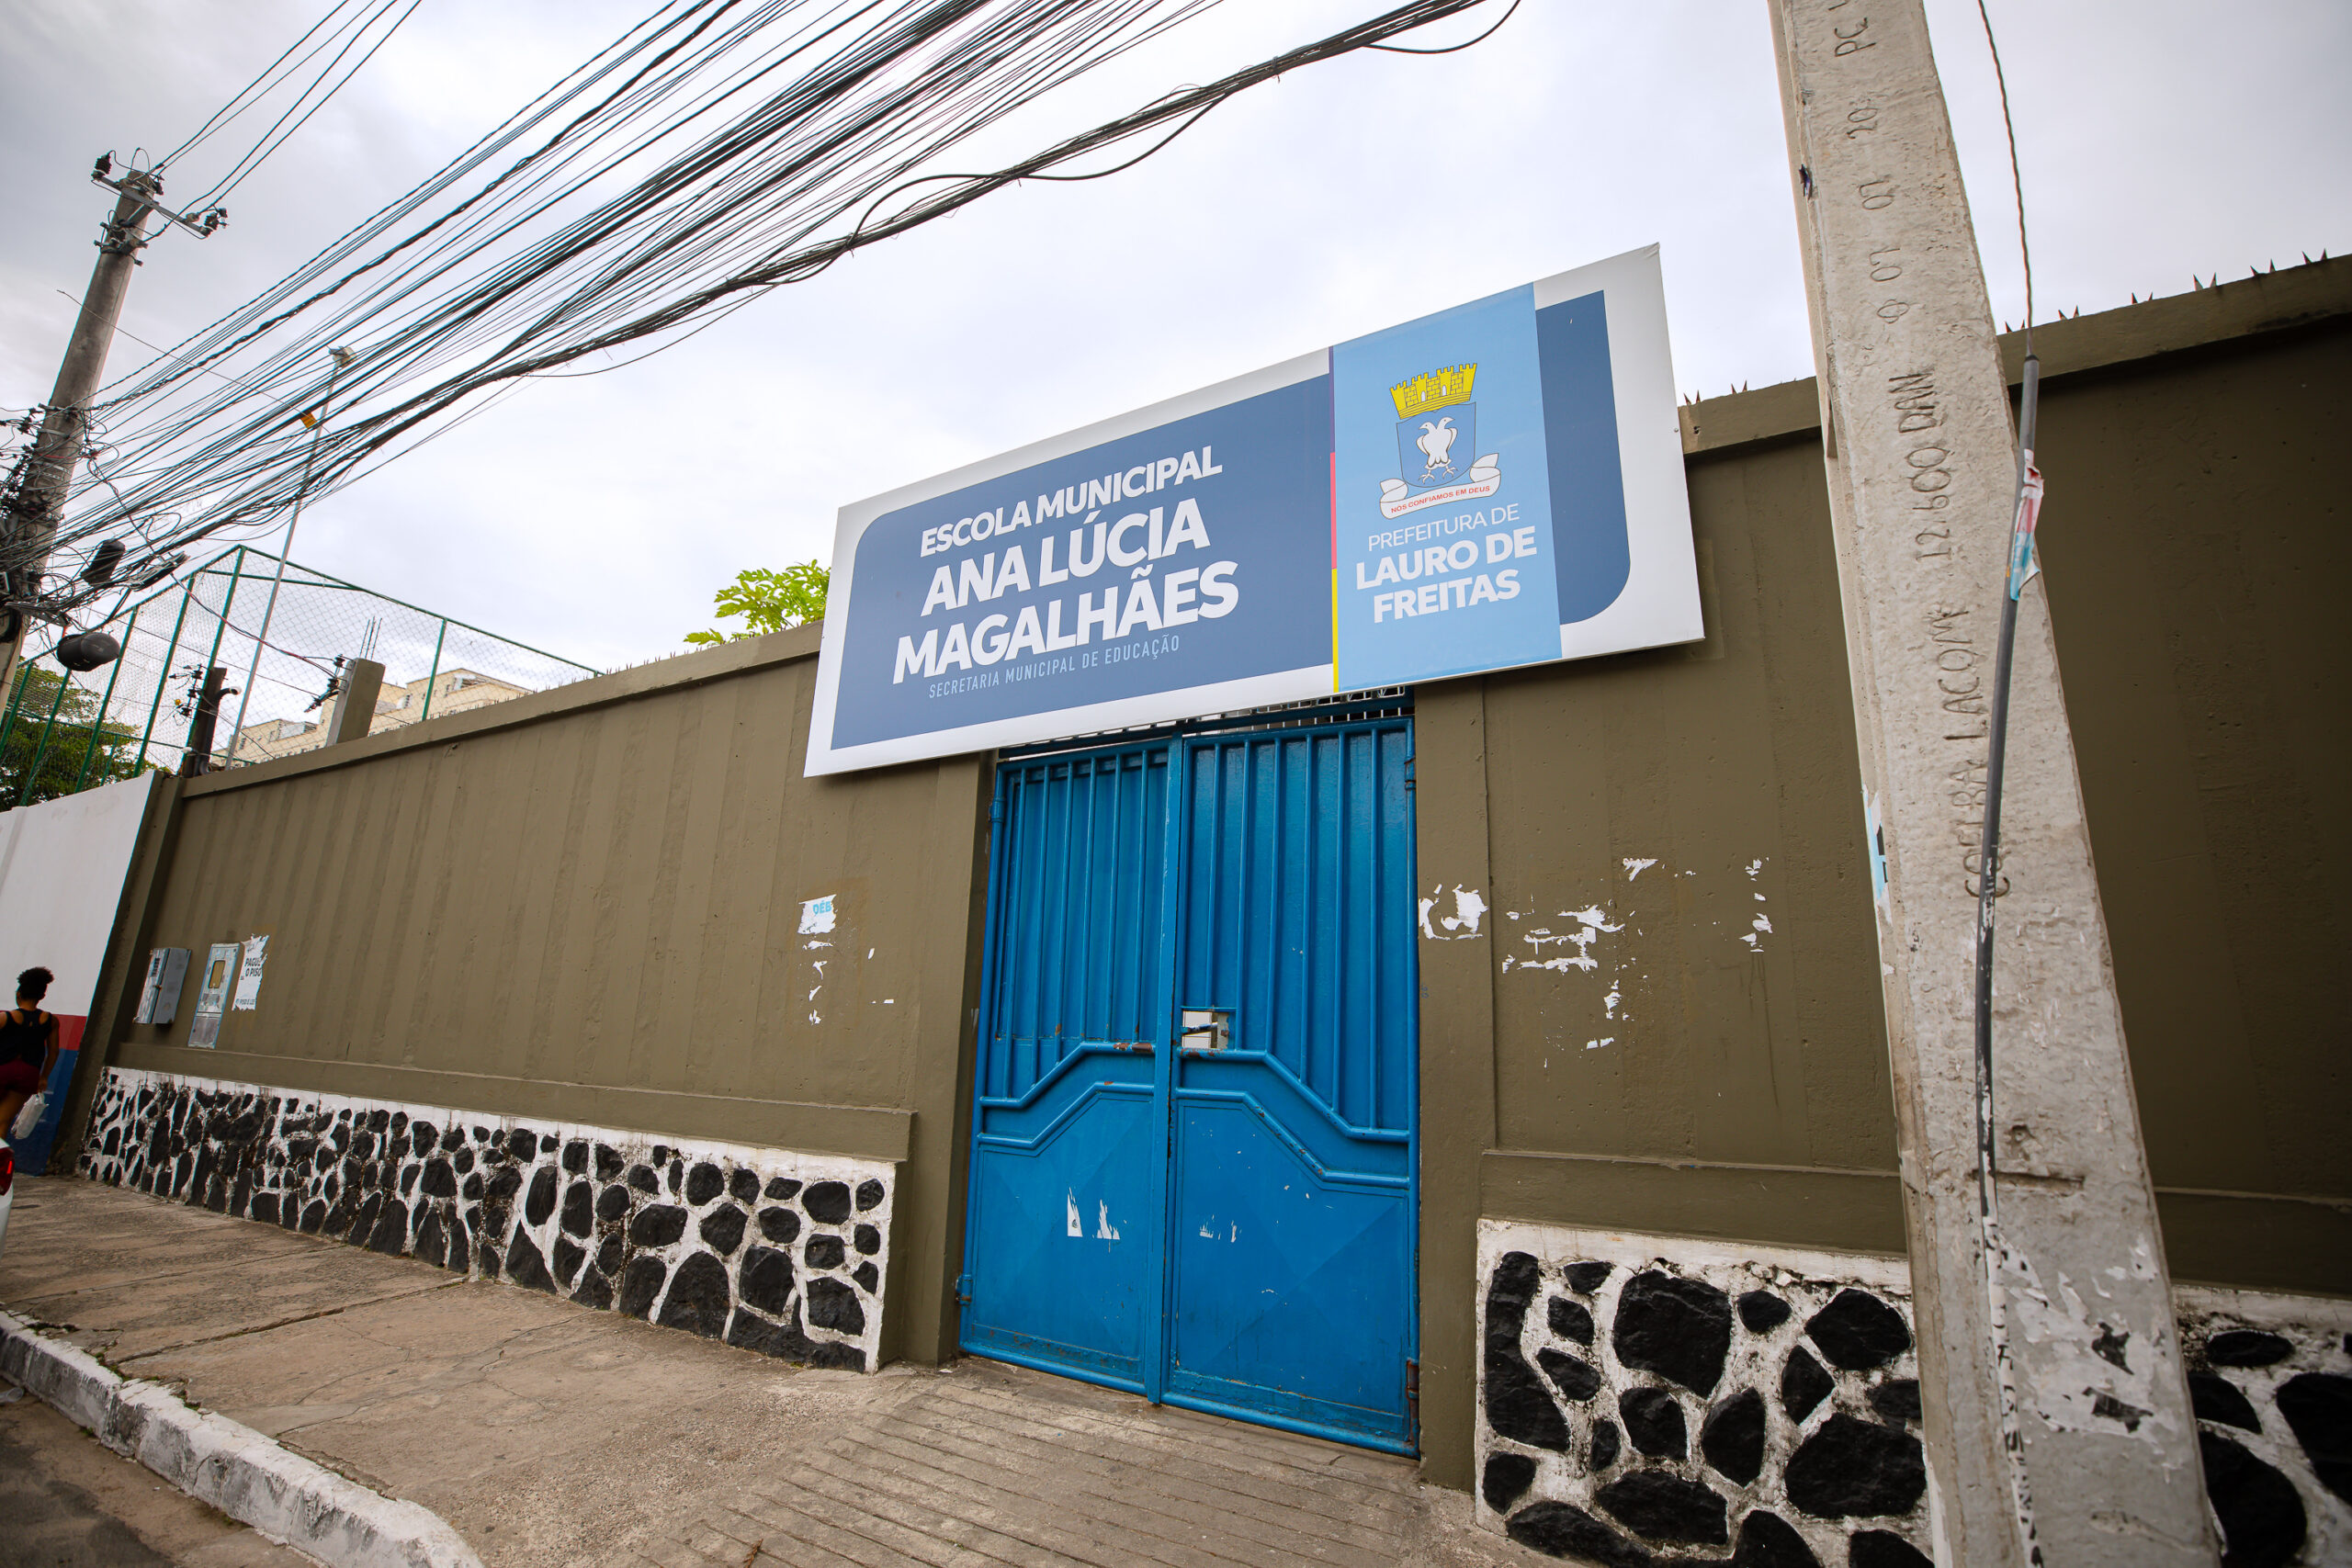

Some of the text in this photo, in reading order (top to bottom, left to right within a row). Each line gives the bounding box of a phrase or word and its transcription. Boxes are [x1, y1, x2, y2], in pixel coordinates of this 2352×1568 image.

[920, 445, 1224, 558] ESCOLA MUNICIPAL
[1367, 502, 1521, 552] PREFEITURA DE
[1390, 485, 1490, 513] NOS CONFIAMOS EM DEUS
[920, 497, 1212, 617] ANA LÚCIA
[1355, 525, 1538, 591] LAURO DE
[892, 559, 1240, 685] MAGALHÃES
[1374, 569, 1521, 624] FREITAS
[928, 634, 1181, 699] SECRETARIA MUNICIPAL DE EDUCAÇÃO
